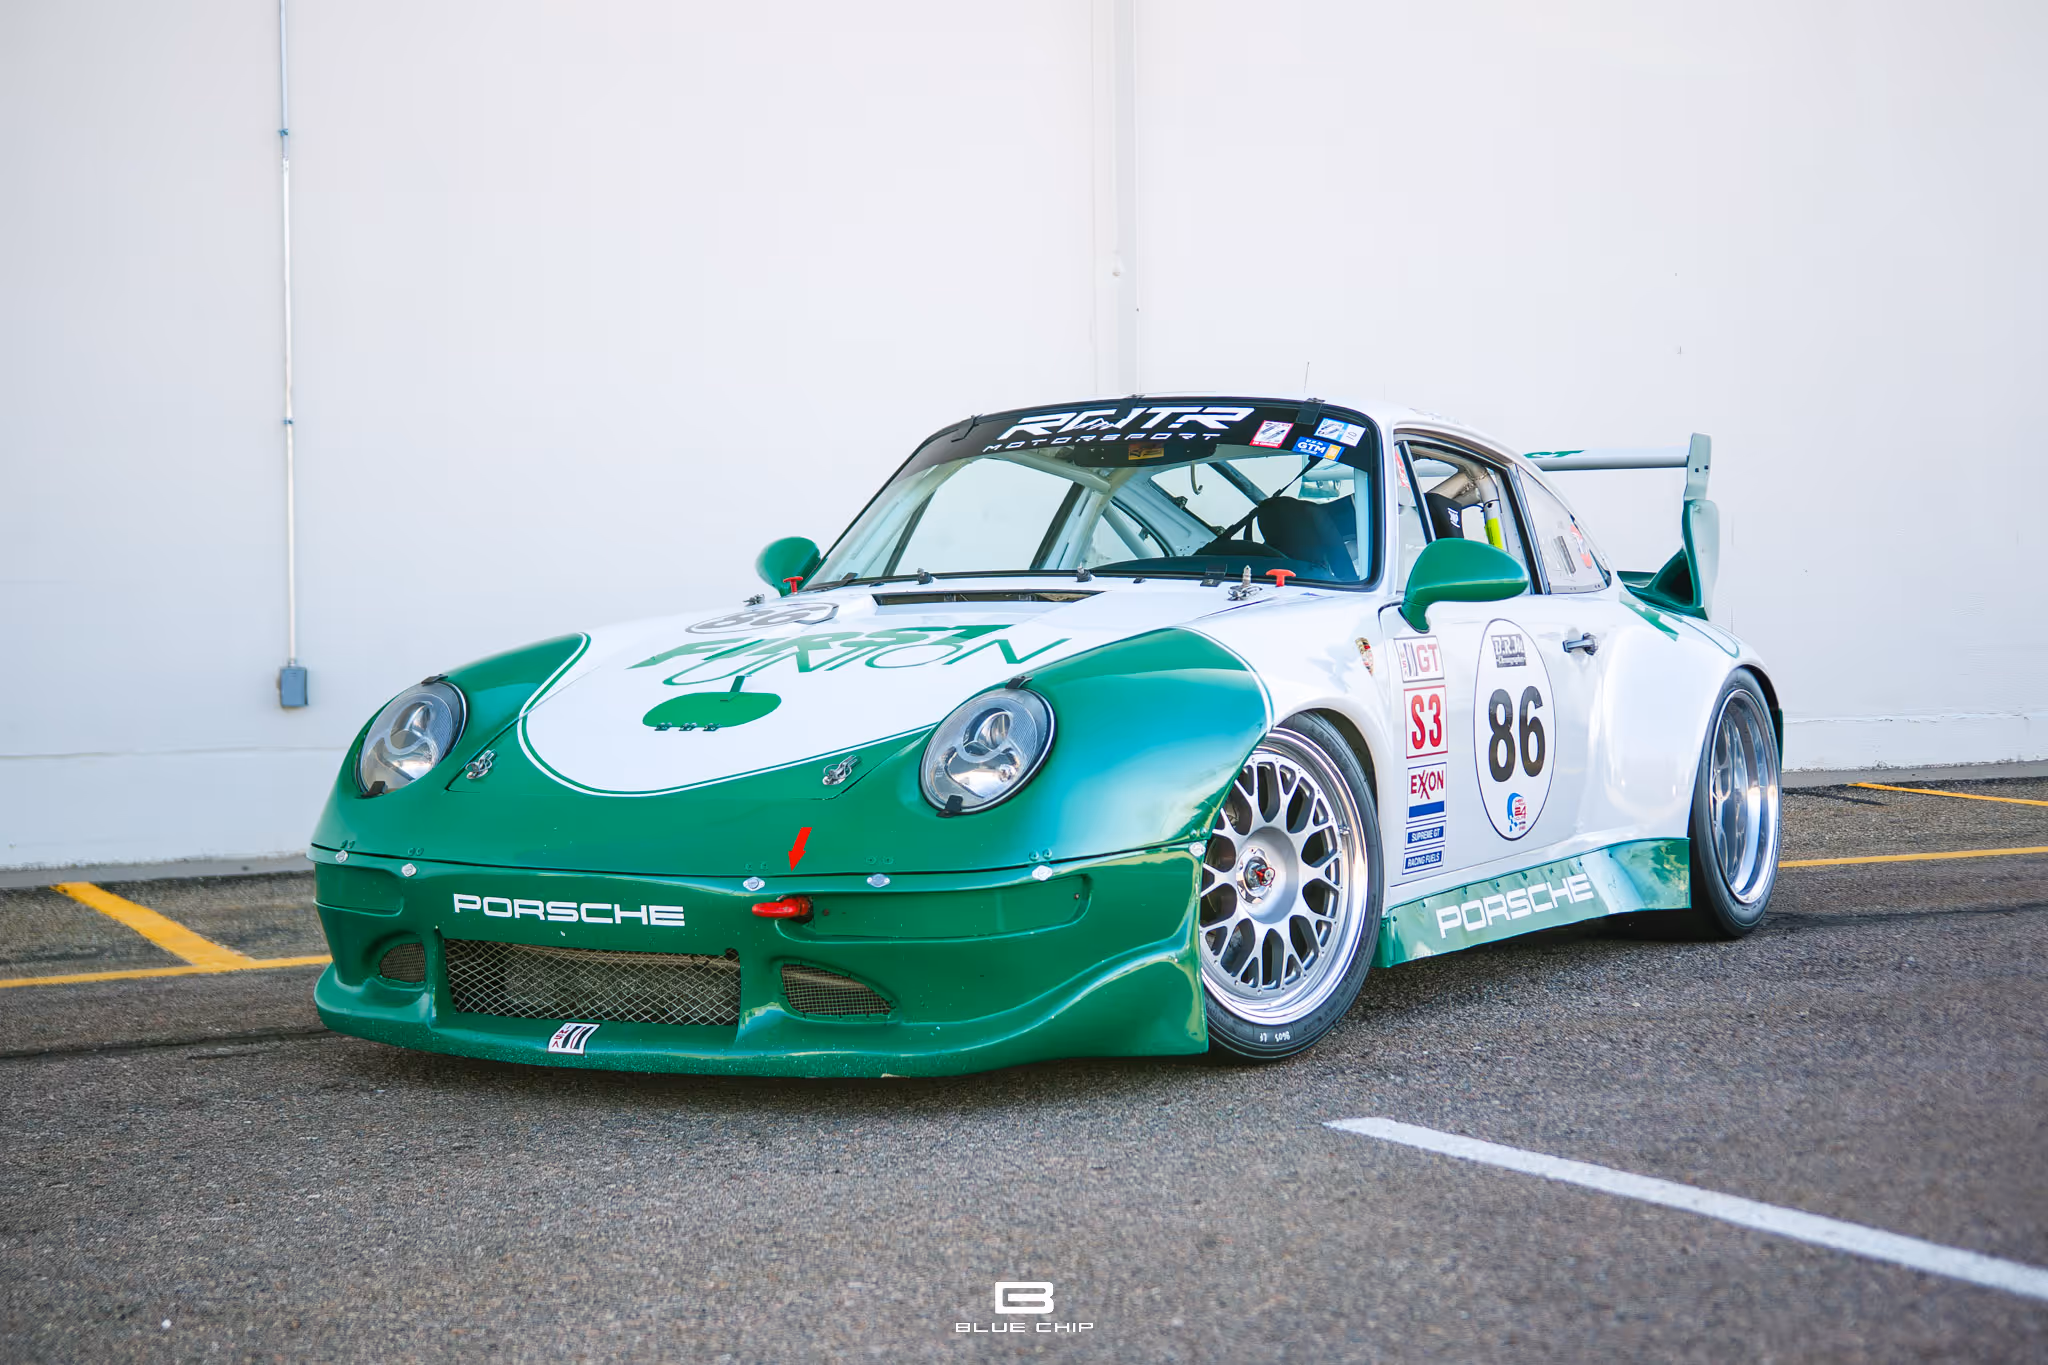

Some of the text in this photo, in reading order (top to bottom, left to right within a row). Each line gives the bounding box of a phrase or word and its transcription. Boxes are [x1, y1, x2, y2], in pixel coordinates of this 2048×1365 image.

[983, 433, 1221, 453] MOTORSPORT
[1297, 441, 1326, 454] GTM
[695, 606, 829, 629] 86
[625, 624, 1016, 669] FIRST
[662, 637, 1073, 686] UNION
[1416, 643, 1439, 672] GT
[1411, 693, 1442, 750] S3
[1488, 685, 1546, 782] 86
[1410, 769, 1444, 800] EXXON
[1411, 828, 1441, 842] SUPREME GT
[1407, 852, 1440, 867] RACING FUELS
[453, 893, 686, 927] PORSCHE
[1436, 873, 1595, 939] PORSCHE
